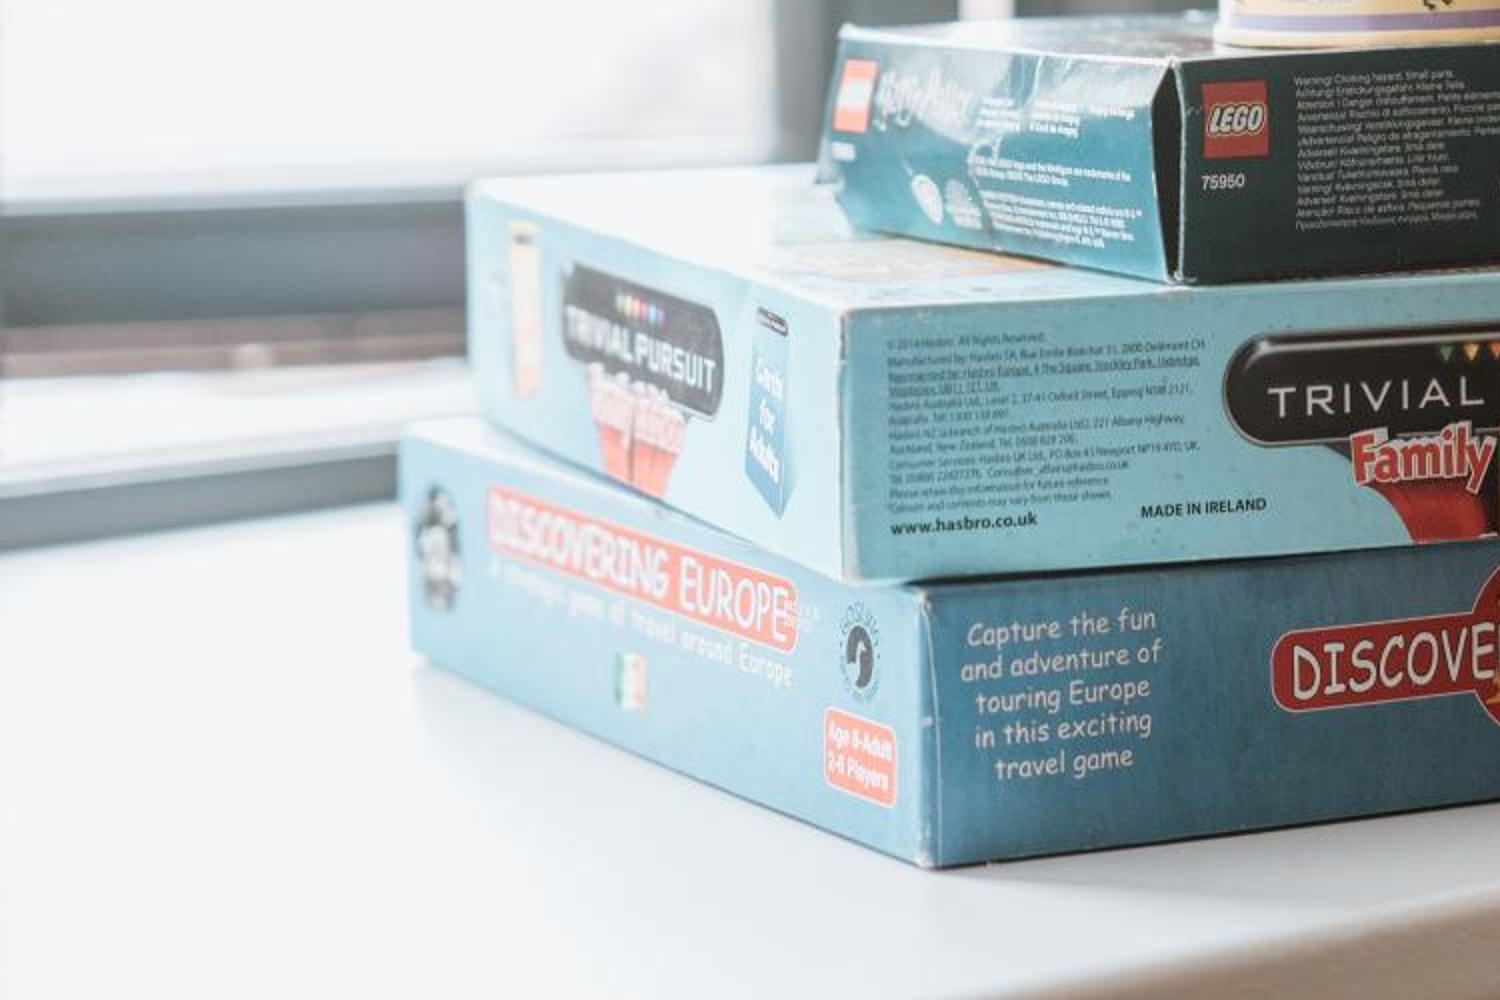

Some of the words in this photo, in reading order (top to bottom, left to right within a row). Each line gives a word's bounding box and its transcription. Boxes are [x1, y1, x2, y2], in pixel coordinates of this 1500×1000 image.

[1208, 104, 1264, 135] LEGO
[1202, 174, 1245, 190] 75950
[635, 332, 716, 393] PURSUIT
[1269, 374, 1485, 418] TRIVIAL
[1350, 421, 1497, 493] Family
[890, 511, 1038, 535] www.hasbro.co.uk
[1141, 502, 1182, 518] MADE
[1187, 502, 1201, 516] IN
[1205, 497, 1268, 514] IRELAND
[680, 555, 788, 643] EUROPE
[967, 618, 1060, 649] Capture
[1069, 611, 1109, 637] the
[1118, 607, 1156, 634] fun
[960, 656, 1001, 682] and
[1010, 646, 1130, 676] adventure
[1137, 637, 1165, 666] of
[975, 686, 1059, 715] touring
[1069, 678, 1151, 707] Europe
[828, 721, 850, 749] Age
[974, 725, 995, 749] in
[1003, 717, 1050, 745] this
[1057, 710, 1152, 740] exciting
[994, 752, 1066, 781] travel
[1074, 747, 1134, 778] game
